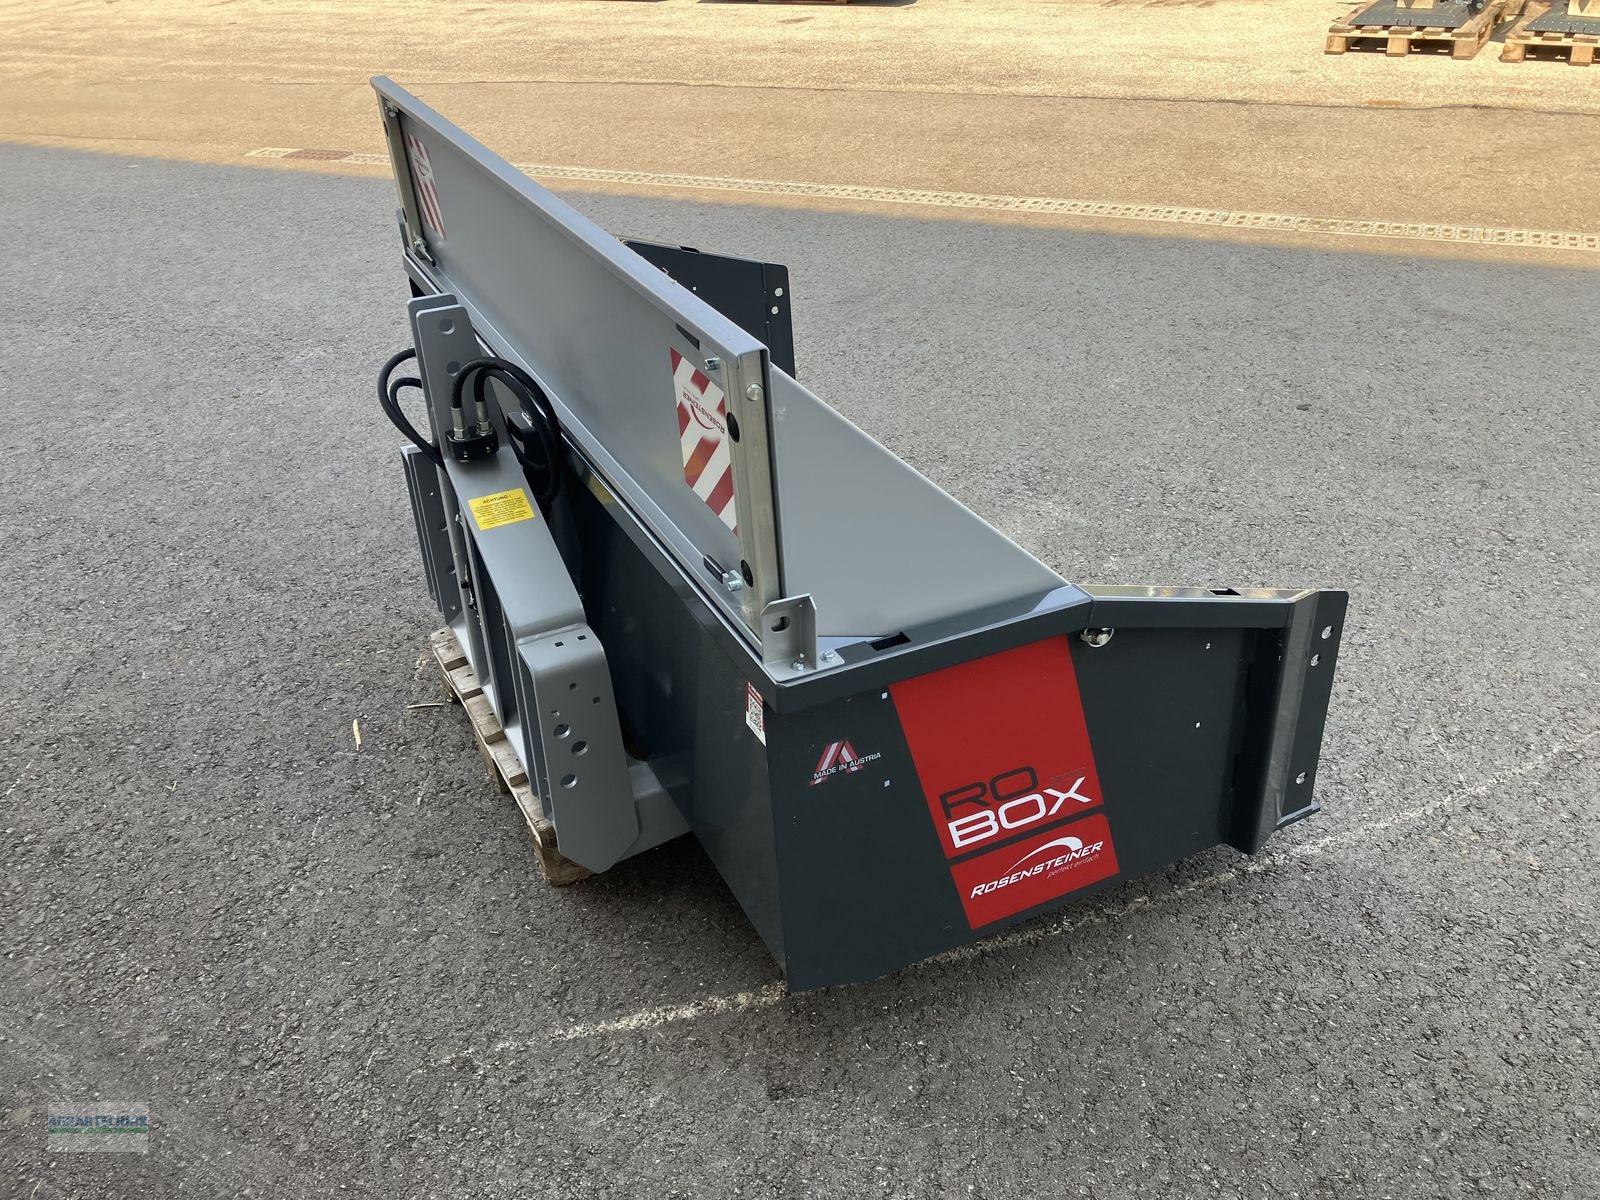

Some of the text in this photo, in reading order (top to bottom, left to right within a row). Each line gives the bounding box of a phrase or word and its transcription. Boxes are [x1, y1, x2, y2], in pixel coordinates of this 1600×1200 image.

[682, 391, 725, 434] ROSENSTEINER
[483, 494, 509, 504] ACHTUNG
[813, 752, 881, 780] MADE IN AUSTRIA
[939, 766, 1039, 819] RO
[947, 776, 1092, 849] BOX
[970, 841, 1104, 899] ROSENSTEINER
